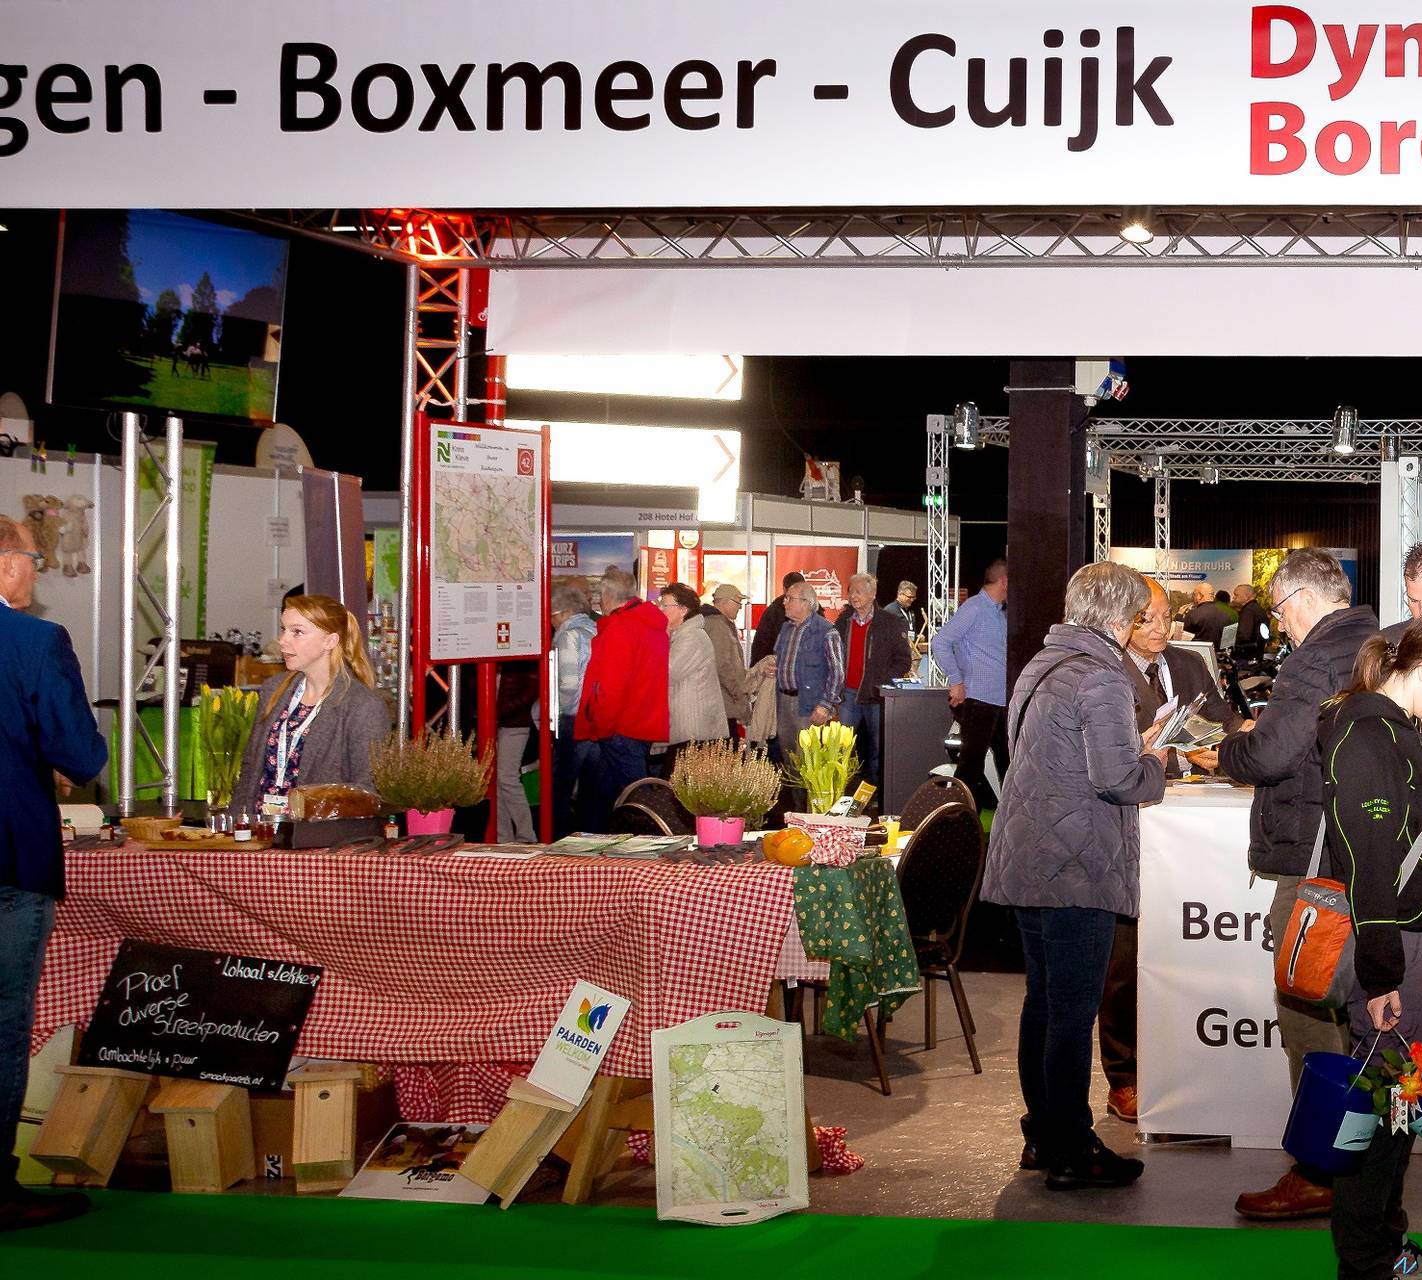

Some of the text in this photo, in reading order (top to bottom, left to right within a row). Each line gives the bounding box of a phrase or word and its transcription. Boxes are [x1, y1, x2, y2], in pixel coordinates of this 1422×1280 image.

[280, 42, 776, 133] Boxmeer
[890, 27, 1174, 151] Cuijk
[638, 513, 652, 521] 208
[655, 513, 677, 521] Hotel
[551, 542, 574, 554] KURZ
[551, 554, 576, 567] TRIPS
[1181, 561, 1202, 570] DER
[222, 955, 265, 980] Lokaal
[116, 964, 183, 1000] Proef
[119, 992, 191, 1026] diverse
[1196, 1007, 1286, 1048] Gen
[556, 1027, 602, 1055] PAARDEN
